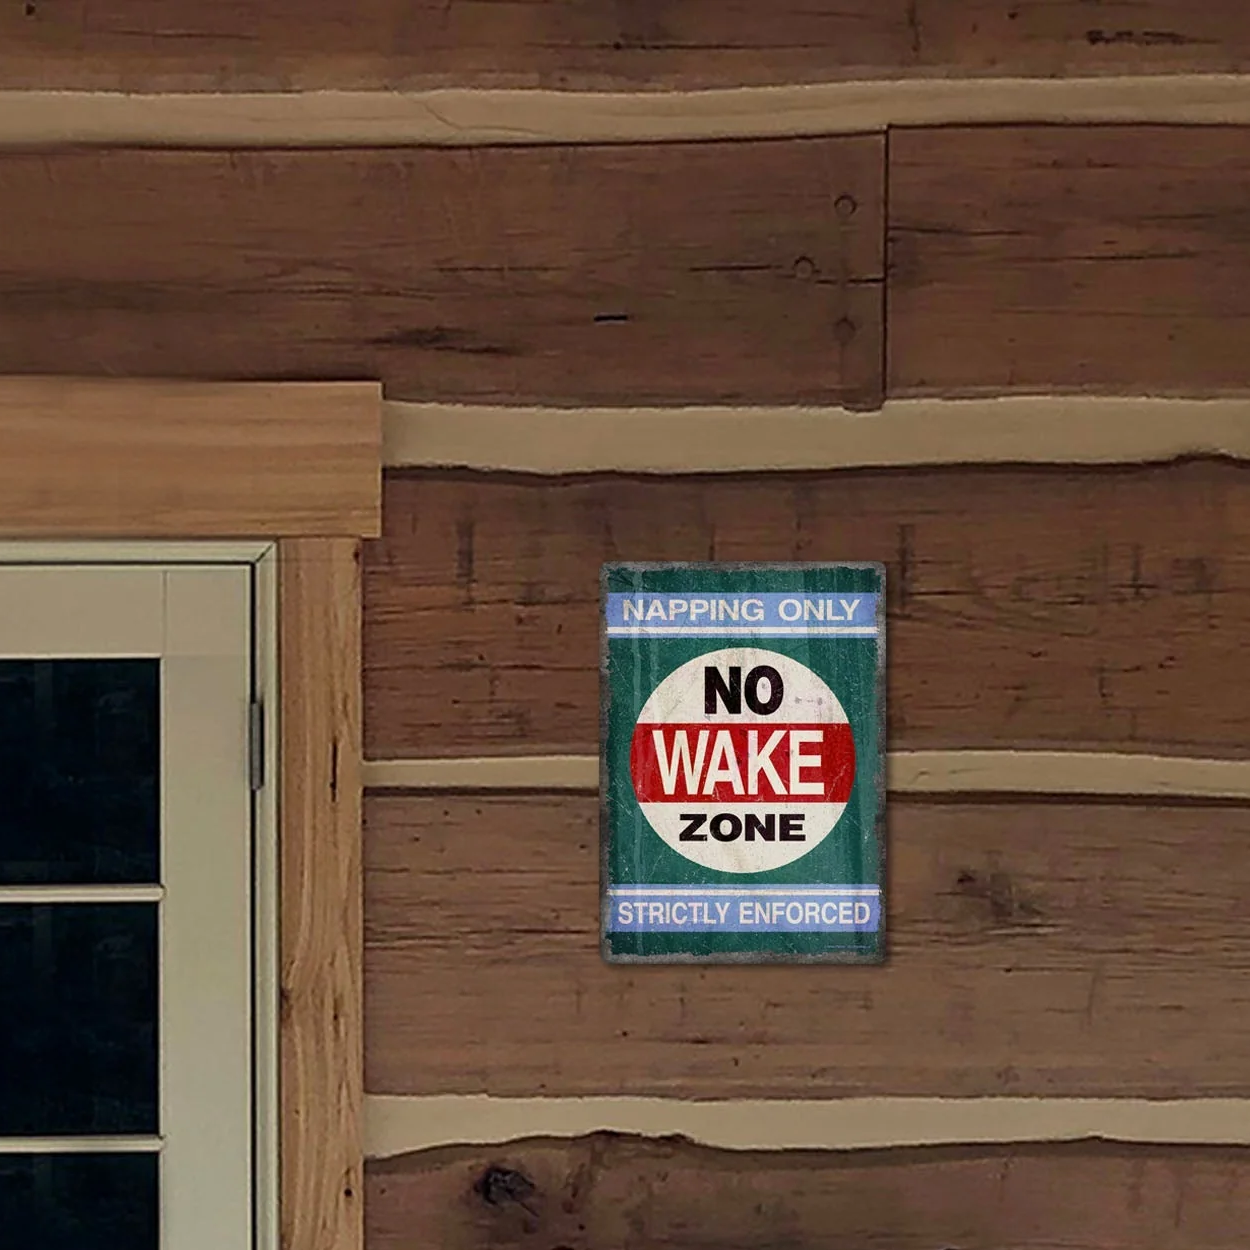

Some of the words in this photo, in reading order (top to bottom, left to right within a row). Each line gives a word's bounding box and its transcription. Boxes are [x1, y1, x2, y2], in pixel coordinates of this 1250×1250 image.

[622, 598, 765, 622] NAPPING
[778, 598, 861, 622] ONLY
[704, 665, 785, 716] NO
[651, 729, 825, 796] WAKE
[678, 813, 806, 842] ZONE
[617, 901, 729, 925] STRICTLY
[739, 901, 871, 925] ENFORCED
